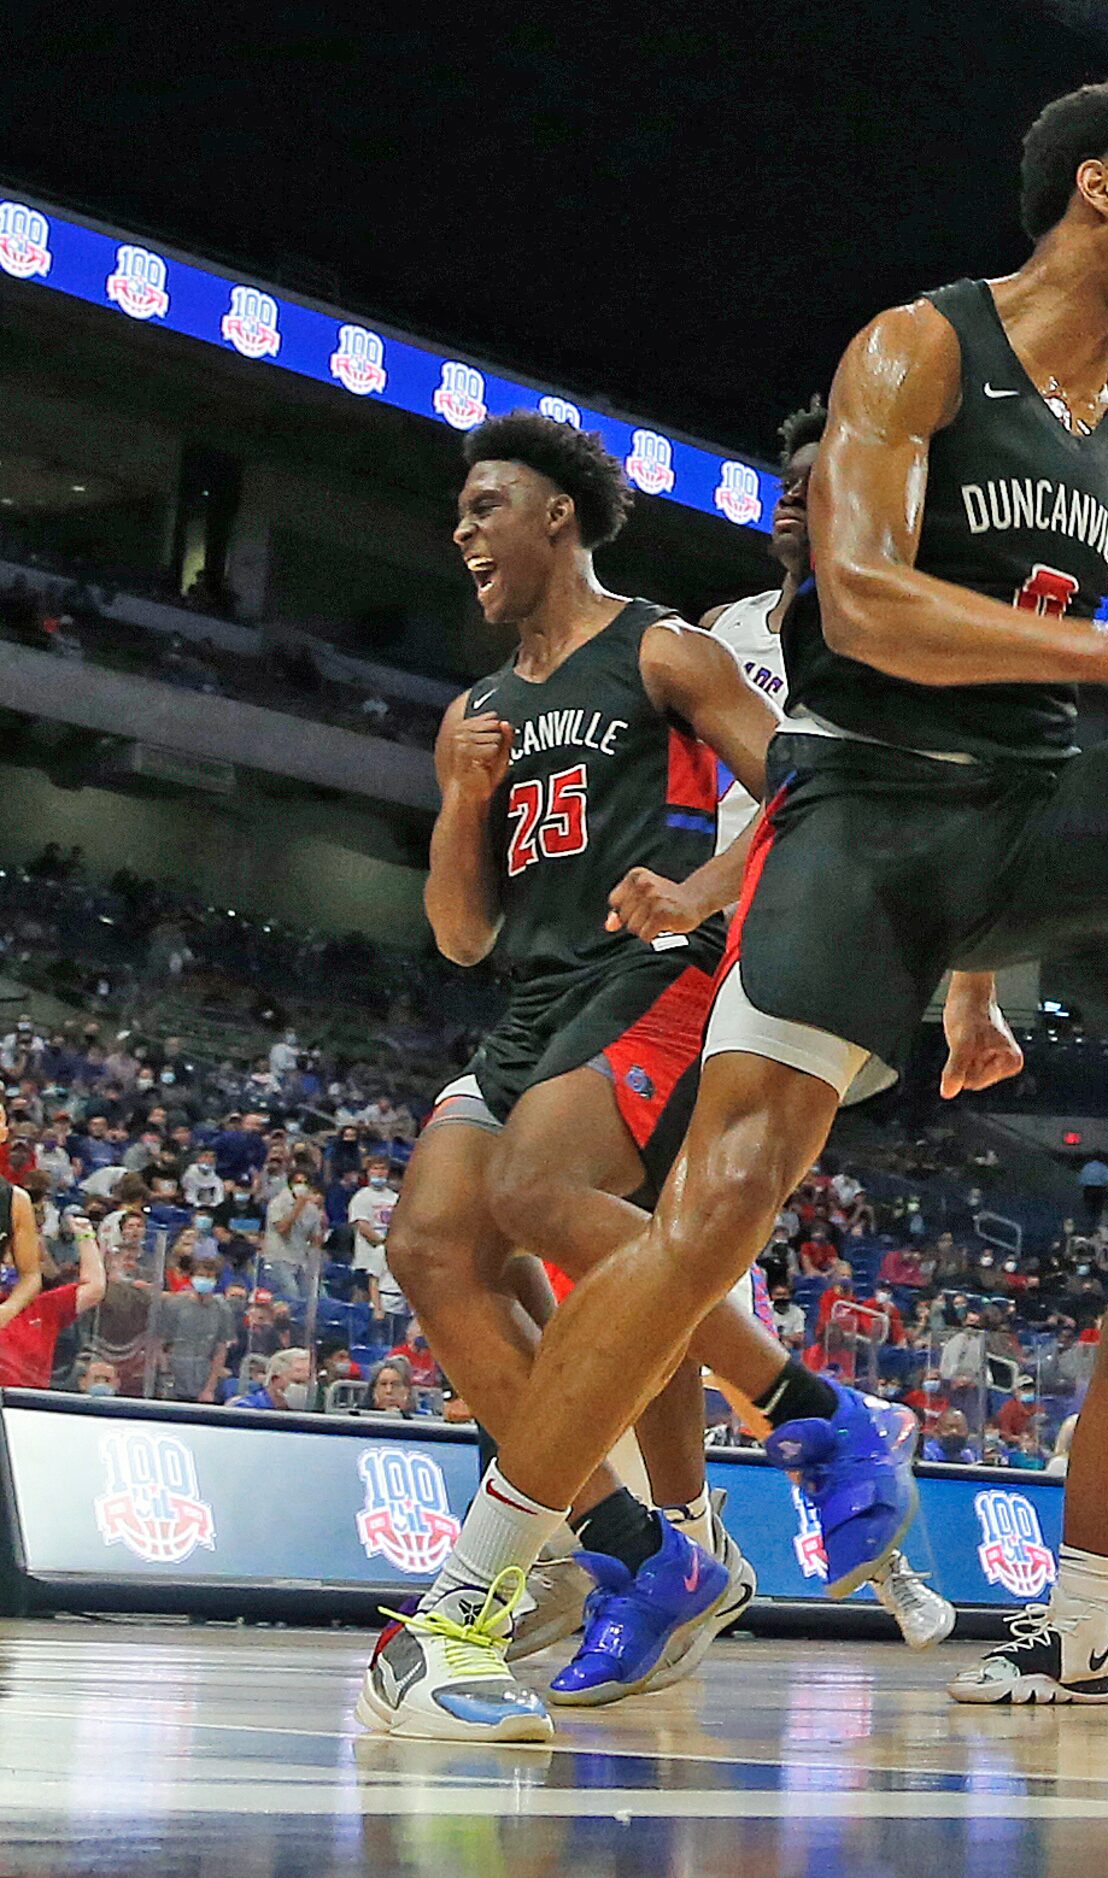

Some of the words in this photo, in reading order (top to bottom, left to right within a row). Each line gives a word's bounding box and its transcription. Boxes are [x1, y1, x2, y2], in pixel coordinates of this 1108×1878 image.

[118, 246, 165, 287] 100
[232, 287, 277, 327] 100
[339, 326, 382, 365] 100
[442, 362, 483, 399] 100
[633, 430, 671, 465] 100
[721, 462, 758, 497] 100
[508, 710, 629, 765] CANVILLE
[508, 764, 588, 876] 25
[102, 1431, 197, 1498] 100
[360, 1449, 446, 1513] 100
[976, 1490, 1043, 1546] 100
